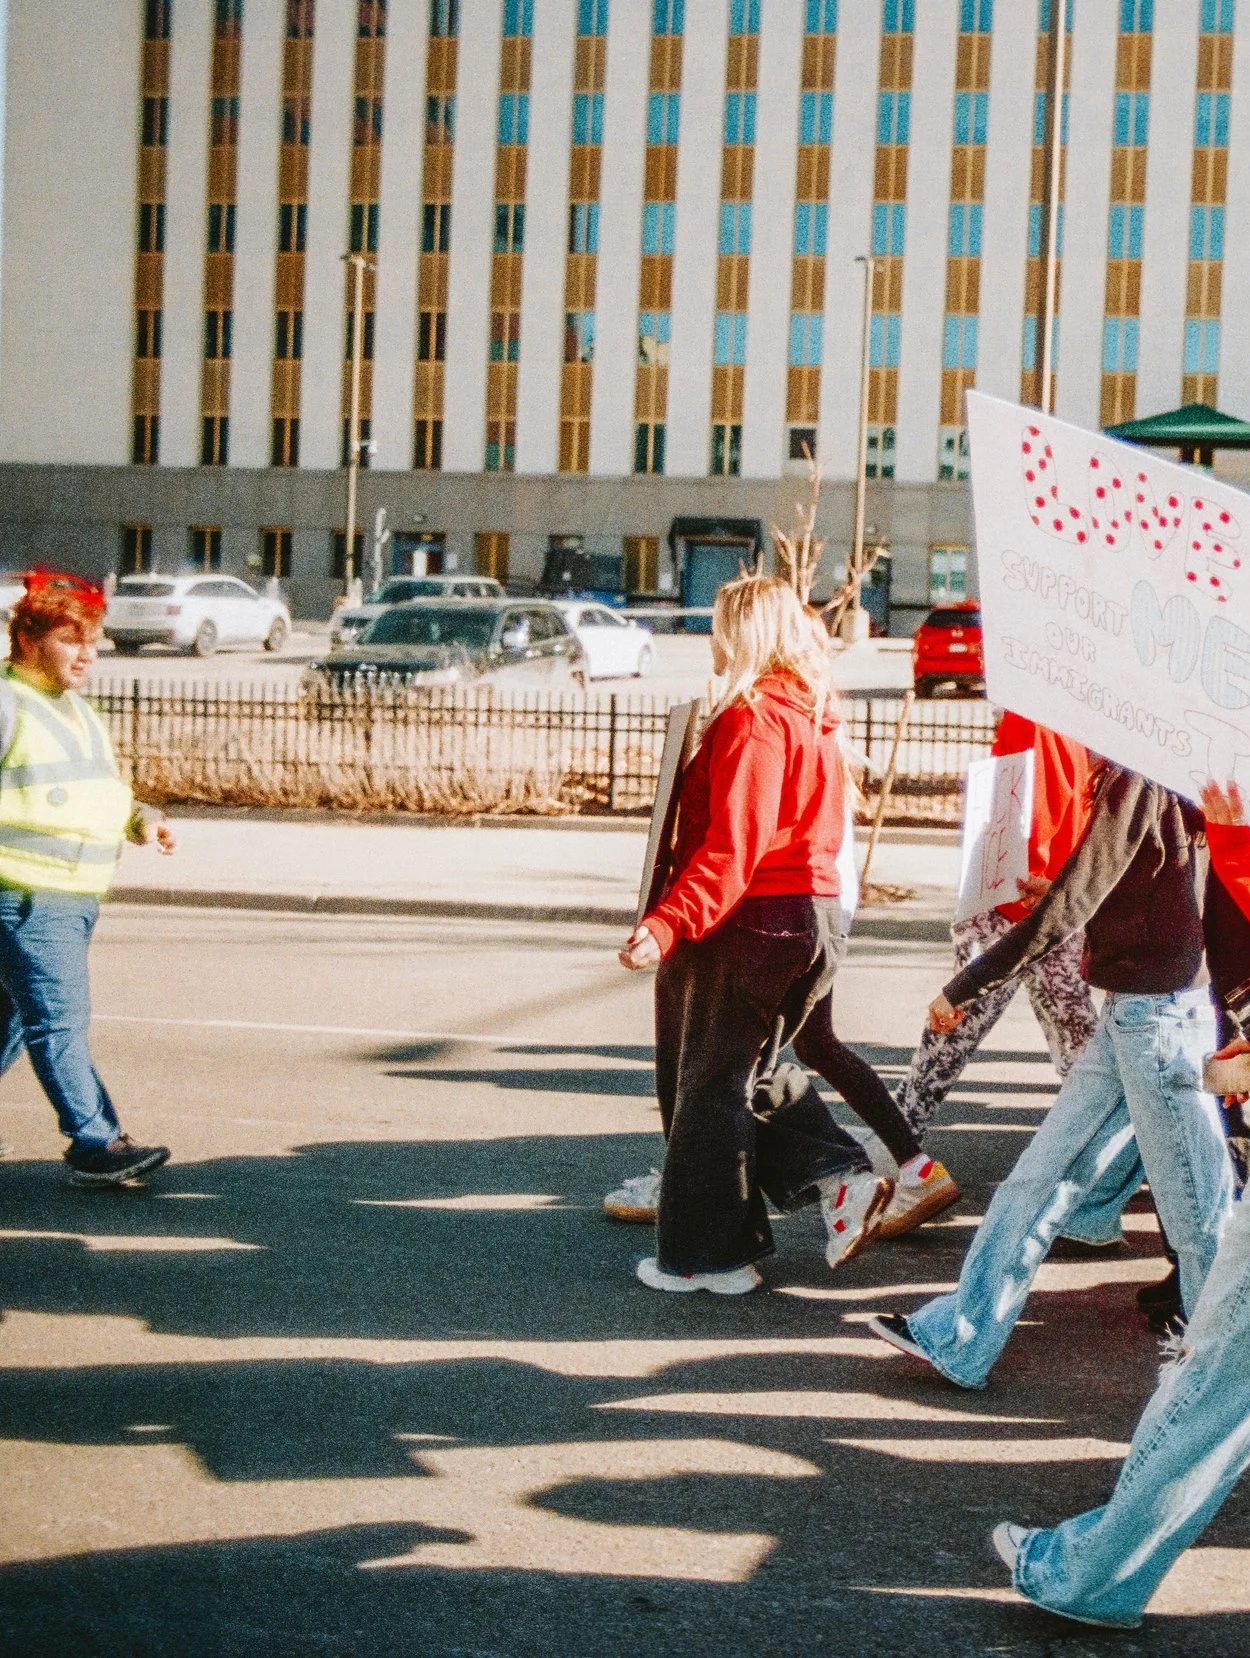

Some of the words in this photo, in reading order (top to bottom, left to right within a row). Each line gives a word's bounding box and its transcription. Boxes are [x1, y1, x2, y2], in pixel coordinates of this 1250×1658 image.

[1021, 425, 1241, 602] LOVE
[1000, 549, 1128, 637] SUPPORT
[1045, 621, 1097, 663] OUR
[1000, 635, 1193, 758] IMMIGRANTS
